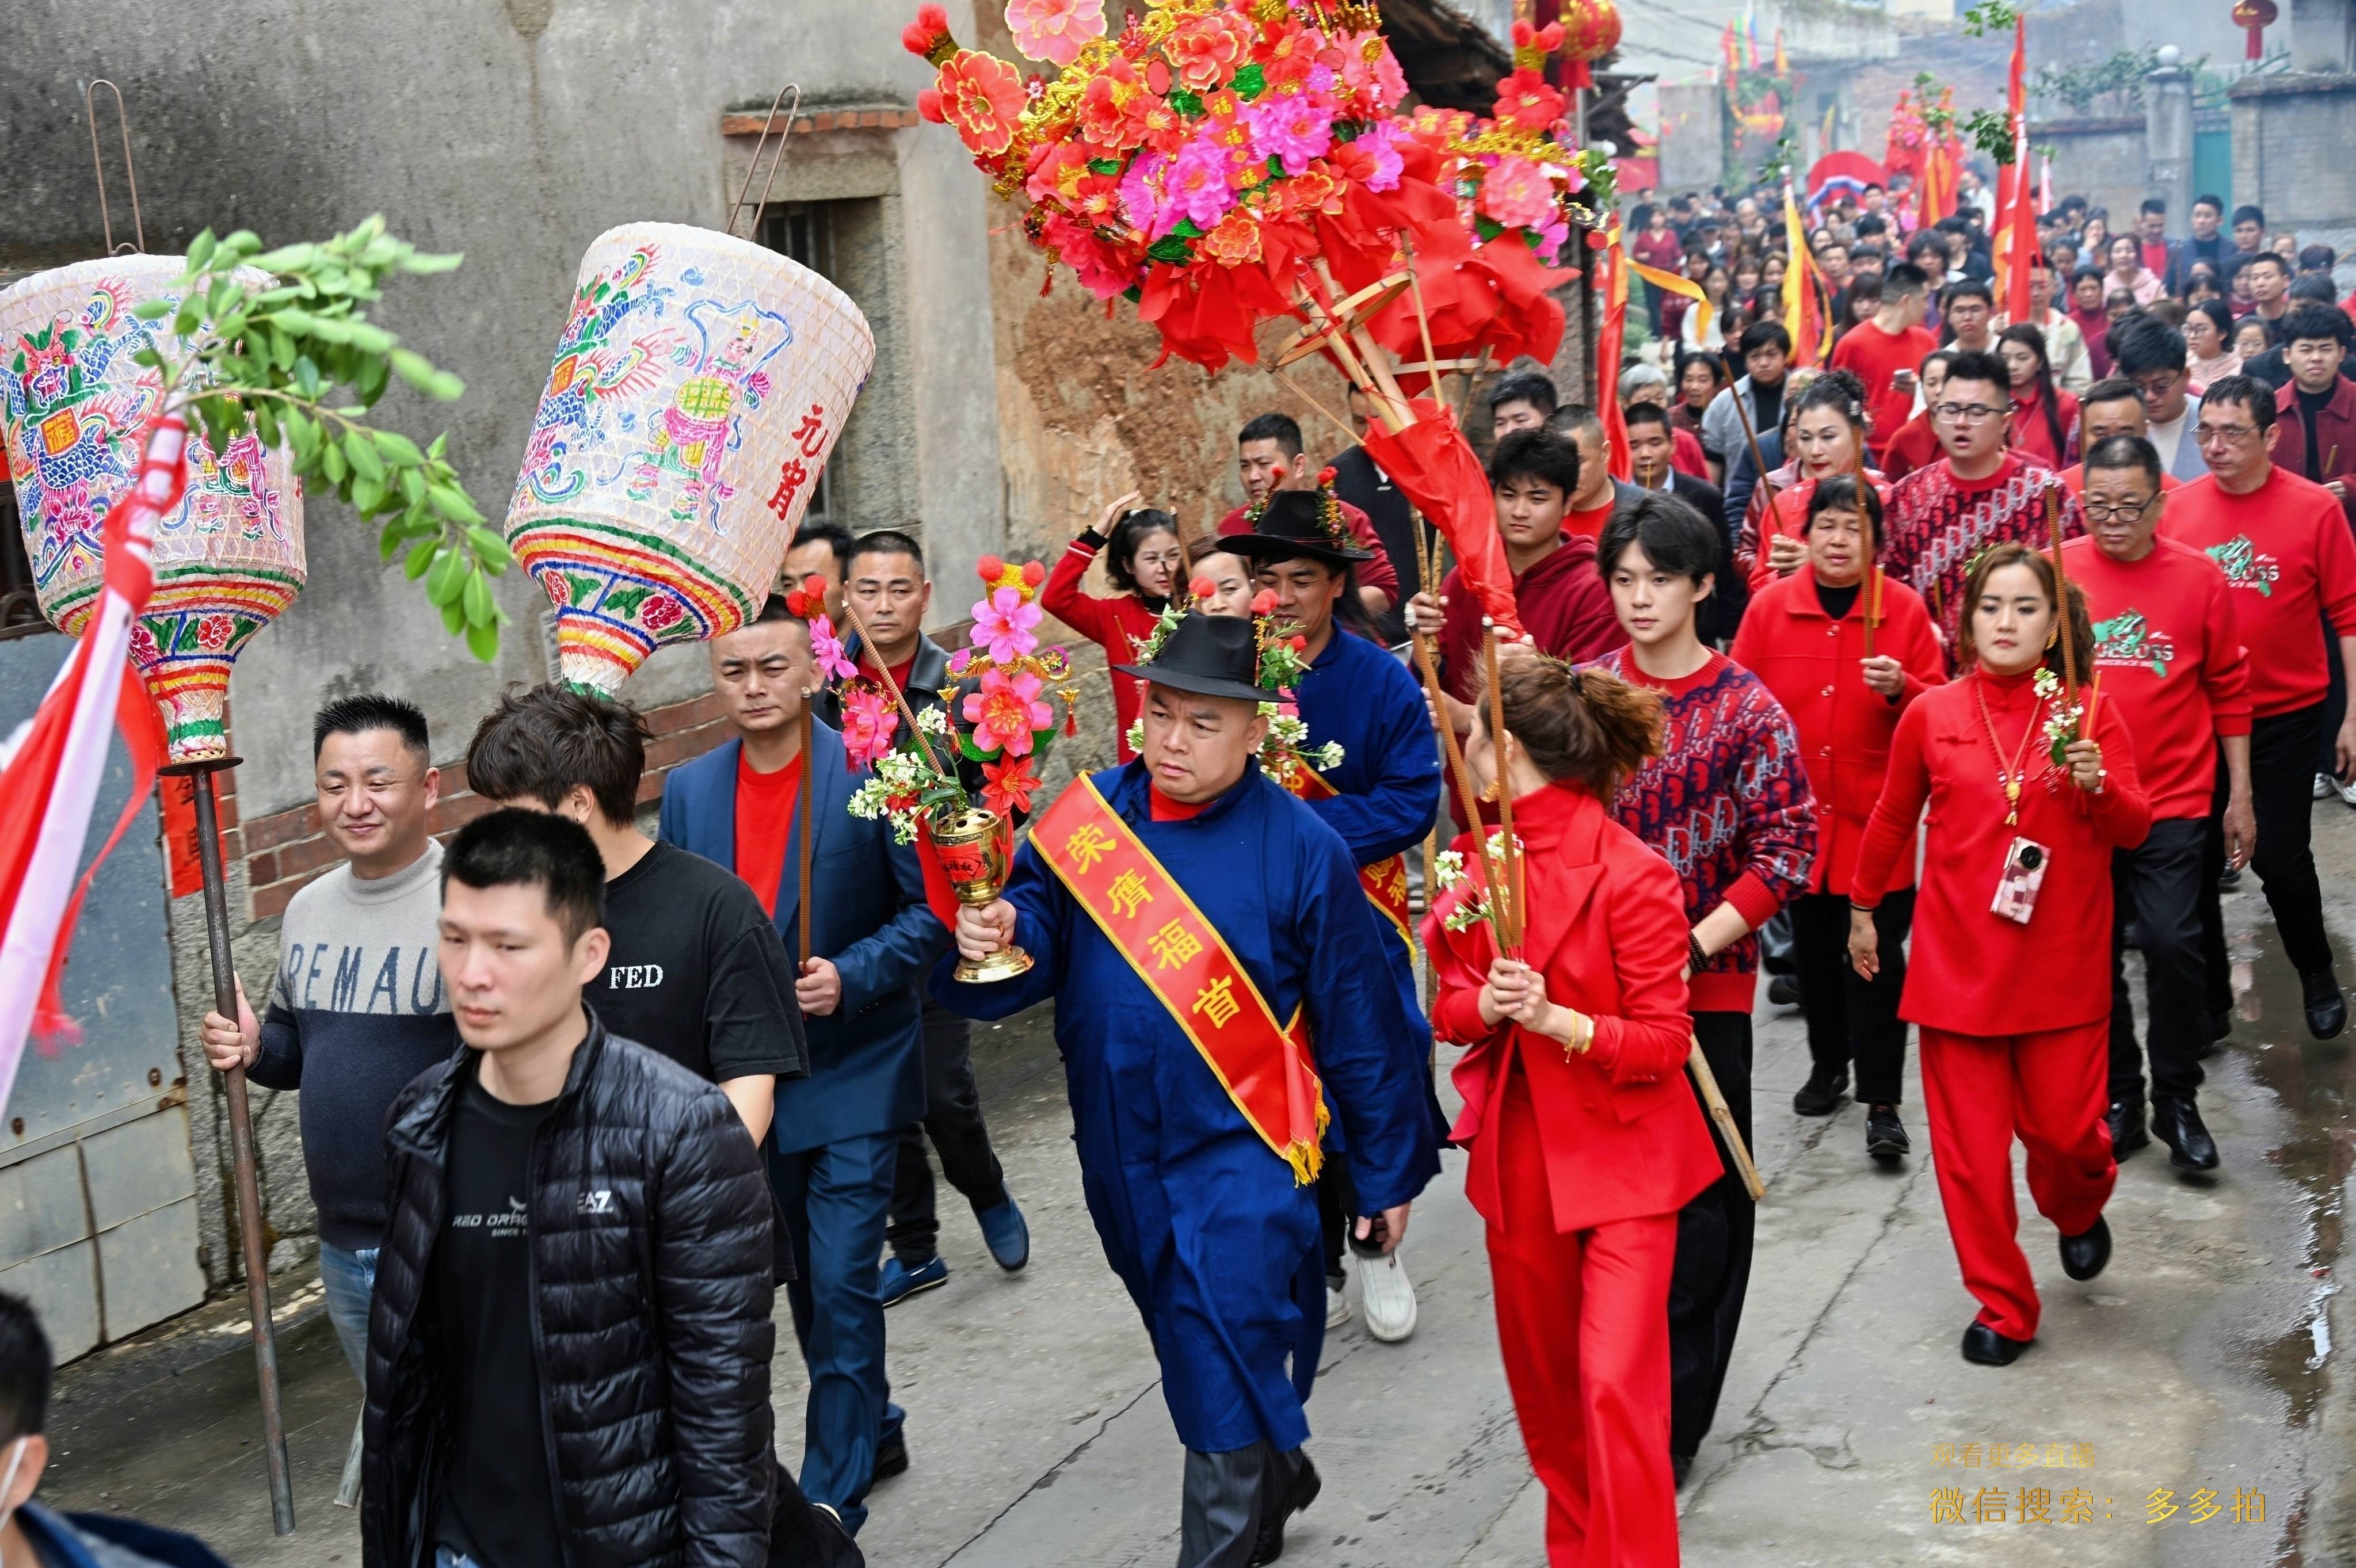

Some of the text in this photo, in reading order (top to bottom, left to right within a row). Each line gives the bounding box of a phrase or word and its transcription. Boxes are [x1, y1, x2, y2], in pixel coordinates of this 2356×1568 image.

[1212, 96, 1233, 116] 福
[1225, 128, 1243, 146] 福
[1240, 168, 1259, 186] 福
[767, 404, 829, 521] 元宵
[1065, 822, 1241, 1029] 荣膺福首
[609, 964, 664, 989] FED
